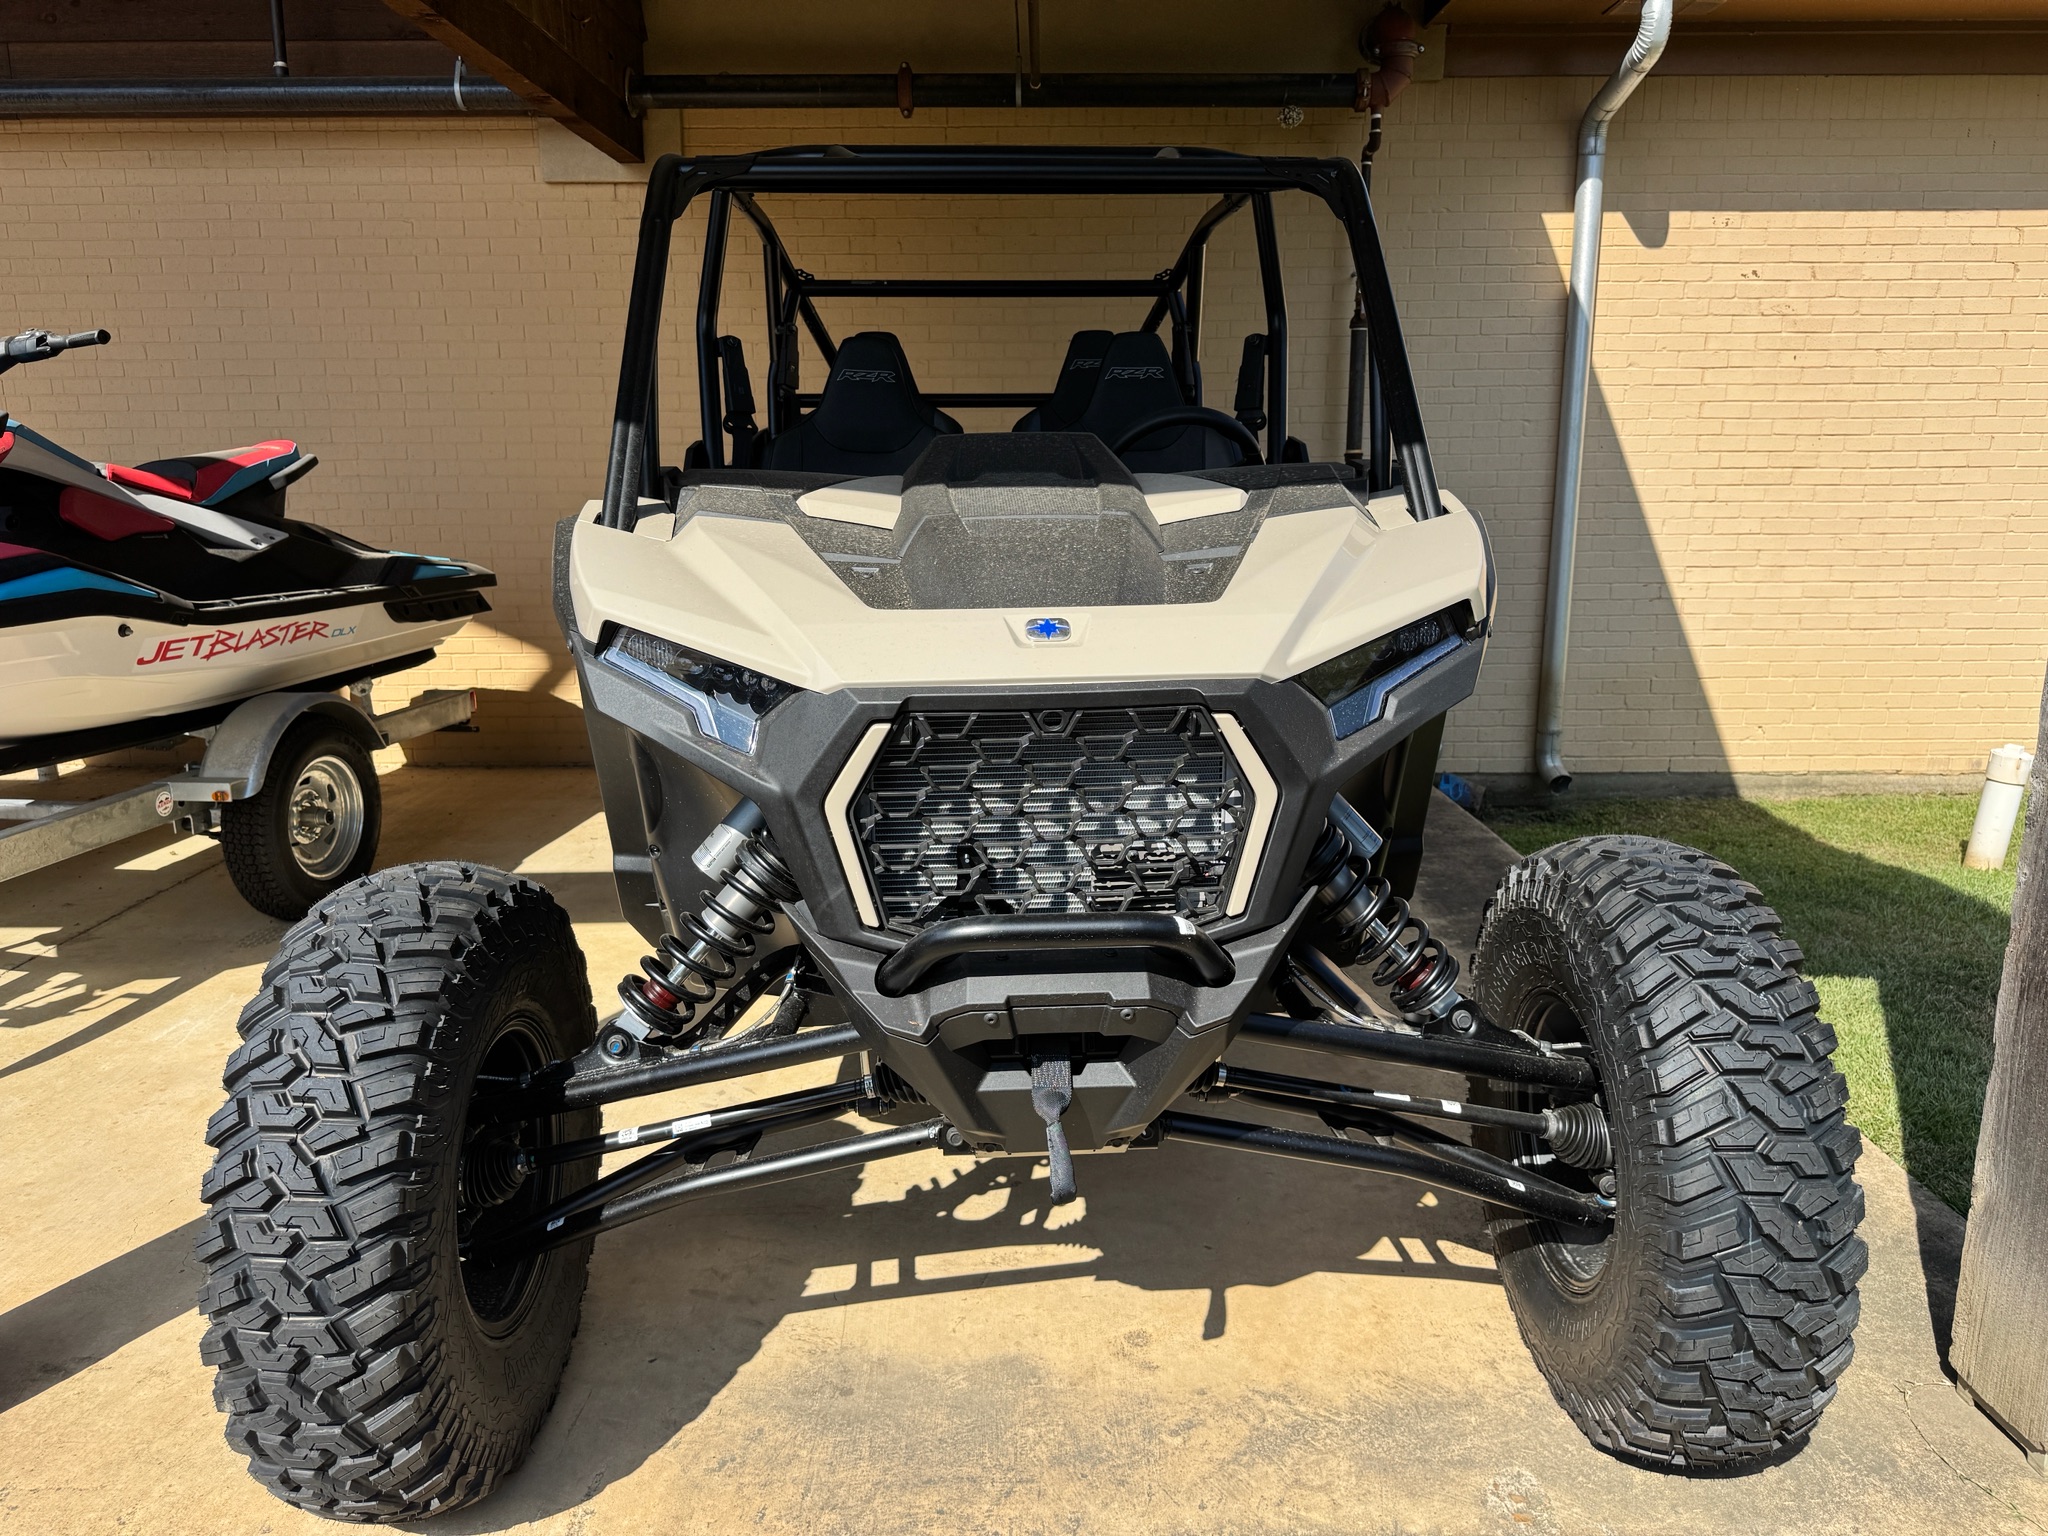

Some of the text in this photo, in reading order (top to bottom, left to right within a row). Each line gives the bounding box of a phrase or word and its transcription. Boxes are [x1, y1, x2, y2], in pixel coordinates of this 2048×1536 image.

[1069, 358, 1103, 370] RZ
[837, 368, 896, 383] RZR
[1104, 366, 1165, 380] RZR
[331, 625, 357, 638] DLX
